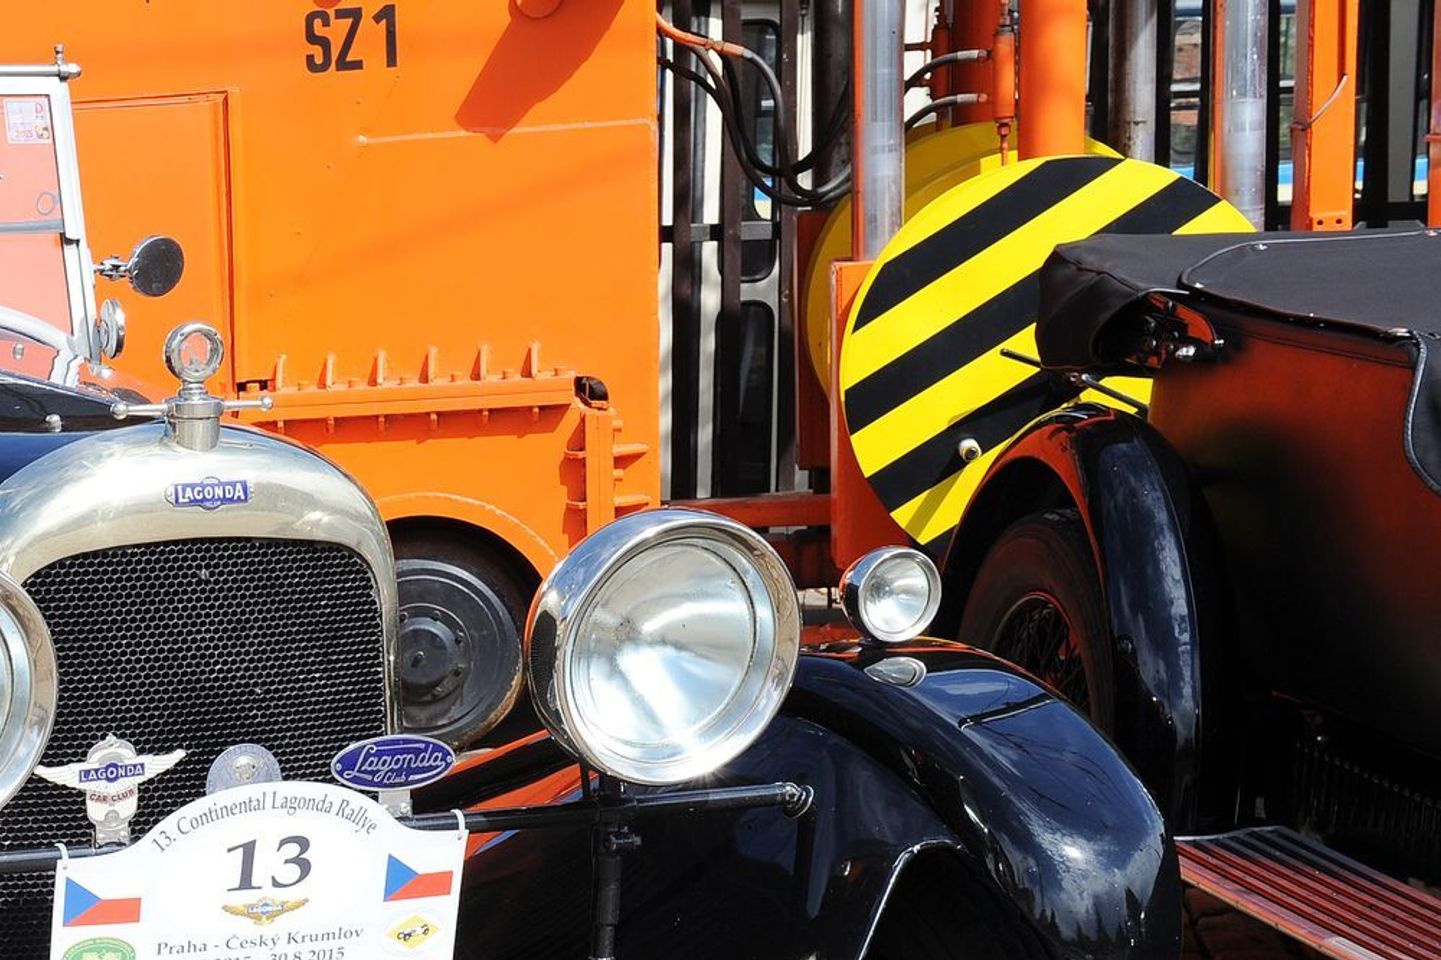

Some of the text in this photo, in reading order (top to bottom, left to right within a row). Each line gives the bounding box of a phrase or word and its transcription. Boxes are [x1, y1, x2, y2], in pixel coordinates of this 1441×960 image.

[177, 483, 245, 502] LAGONDA
[81, 764, 143, 780] LAGONDA
[343, 744, 447, 782] Lagonda
[383, 771, 406, 784] Club
[90, 788, 135, 803] CAR CLUB
[151, 791, 378, 853] 13. Continental Lagonda Rallye
[226, 835, 312, 892] 13
[156, 940, 208, 956] Praha
[225, 934, 280, 950] Český
[286, 926, 364, 945] Krumlov
